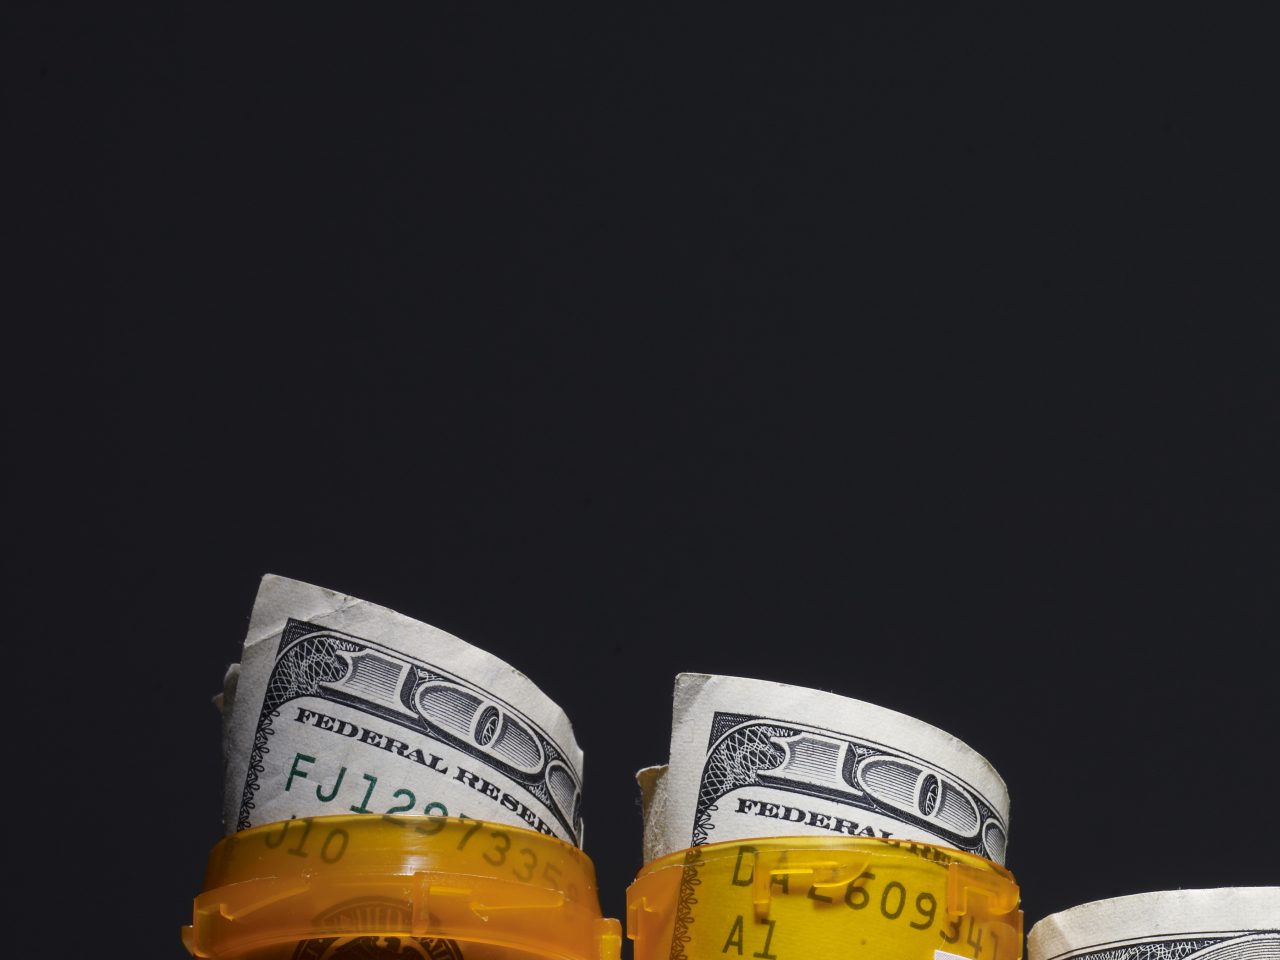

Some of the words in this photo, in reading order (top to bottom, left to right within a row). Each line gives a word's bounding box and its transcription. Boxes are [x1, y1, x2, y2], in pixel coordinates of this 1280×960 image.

[294, 707, 449, 774] FEDERAL
[453, 766, 559, 837] RESER
[266, 814, 348, 864] J10
[724, 915, 777, 960] A1
